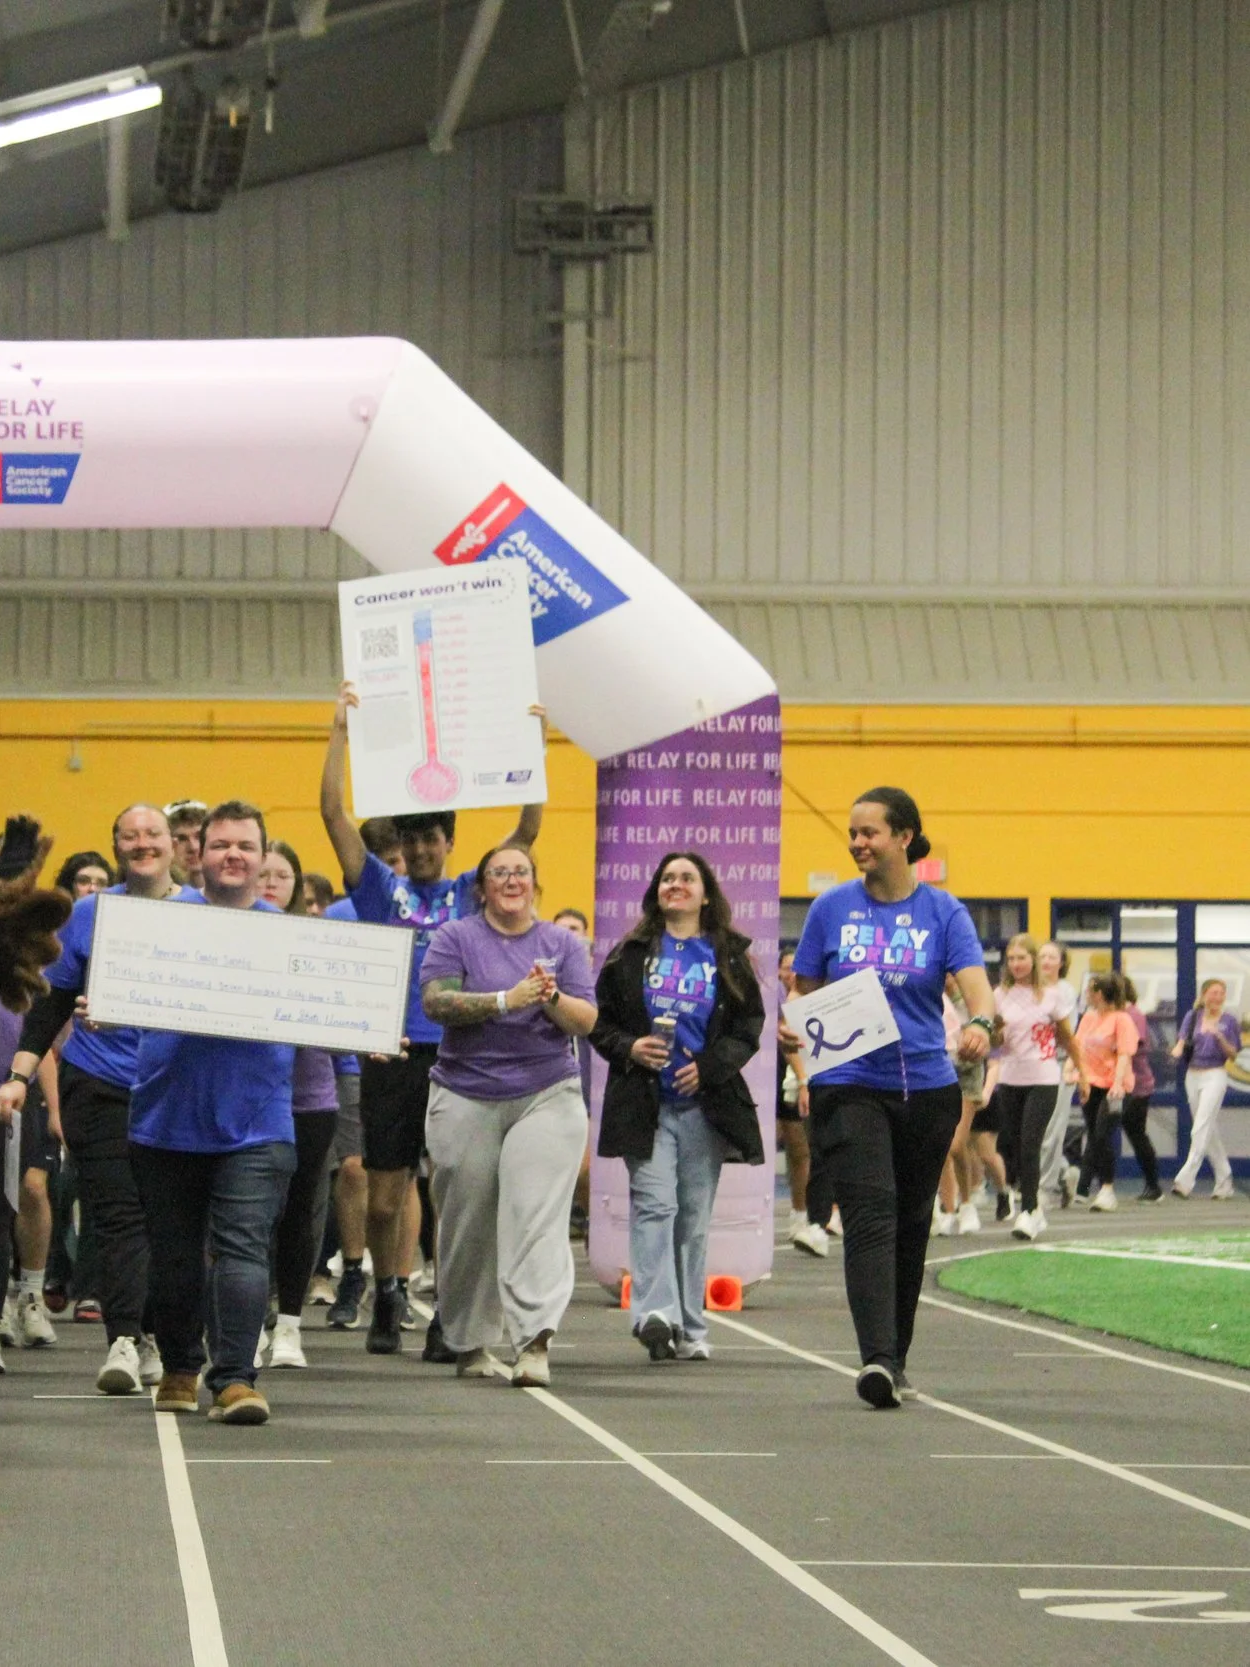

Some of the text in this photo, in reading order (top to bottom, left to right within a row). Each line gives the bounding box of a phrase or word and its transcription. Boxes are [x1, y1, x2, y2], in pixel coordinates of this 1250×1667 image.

[36, 421, 84, 440] LIFE
[6, 465, 67, 478] American
[6, 476, 50, 486] Cancer
[6, 485, 53, 497] Society
[508, 529, 593, 610] American
[354, 576, 502, 606] Cancer won't win
[750, 715, 774, 733] FOR
[626, 752, 680, 769] RELAY
[685, 752, 721, 769] FOR
[726, 752, 757, 770] LIFE
[613, 789, 641, 806] FOR
[646, 789, 682, 806] LIFE
[693, 789, 747, 807] RELAY
[750, 789, 774, 807] FOR
[626, 826, 679, 844] RELAY
[684, 826, 720, 844] FOR
[726, 827, 756, 844] LIFE
[613, 864, 640, 880] FOR
[750, 864, 773, 881] FOR
[733, 901, 756, 918] IFE
[840, 923, 930, 950] RELAY
[837, 945, 928, 969] FOR LIFE
[678, 978, 717, 999] LIFE
